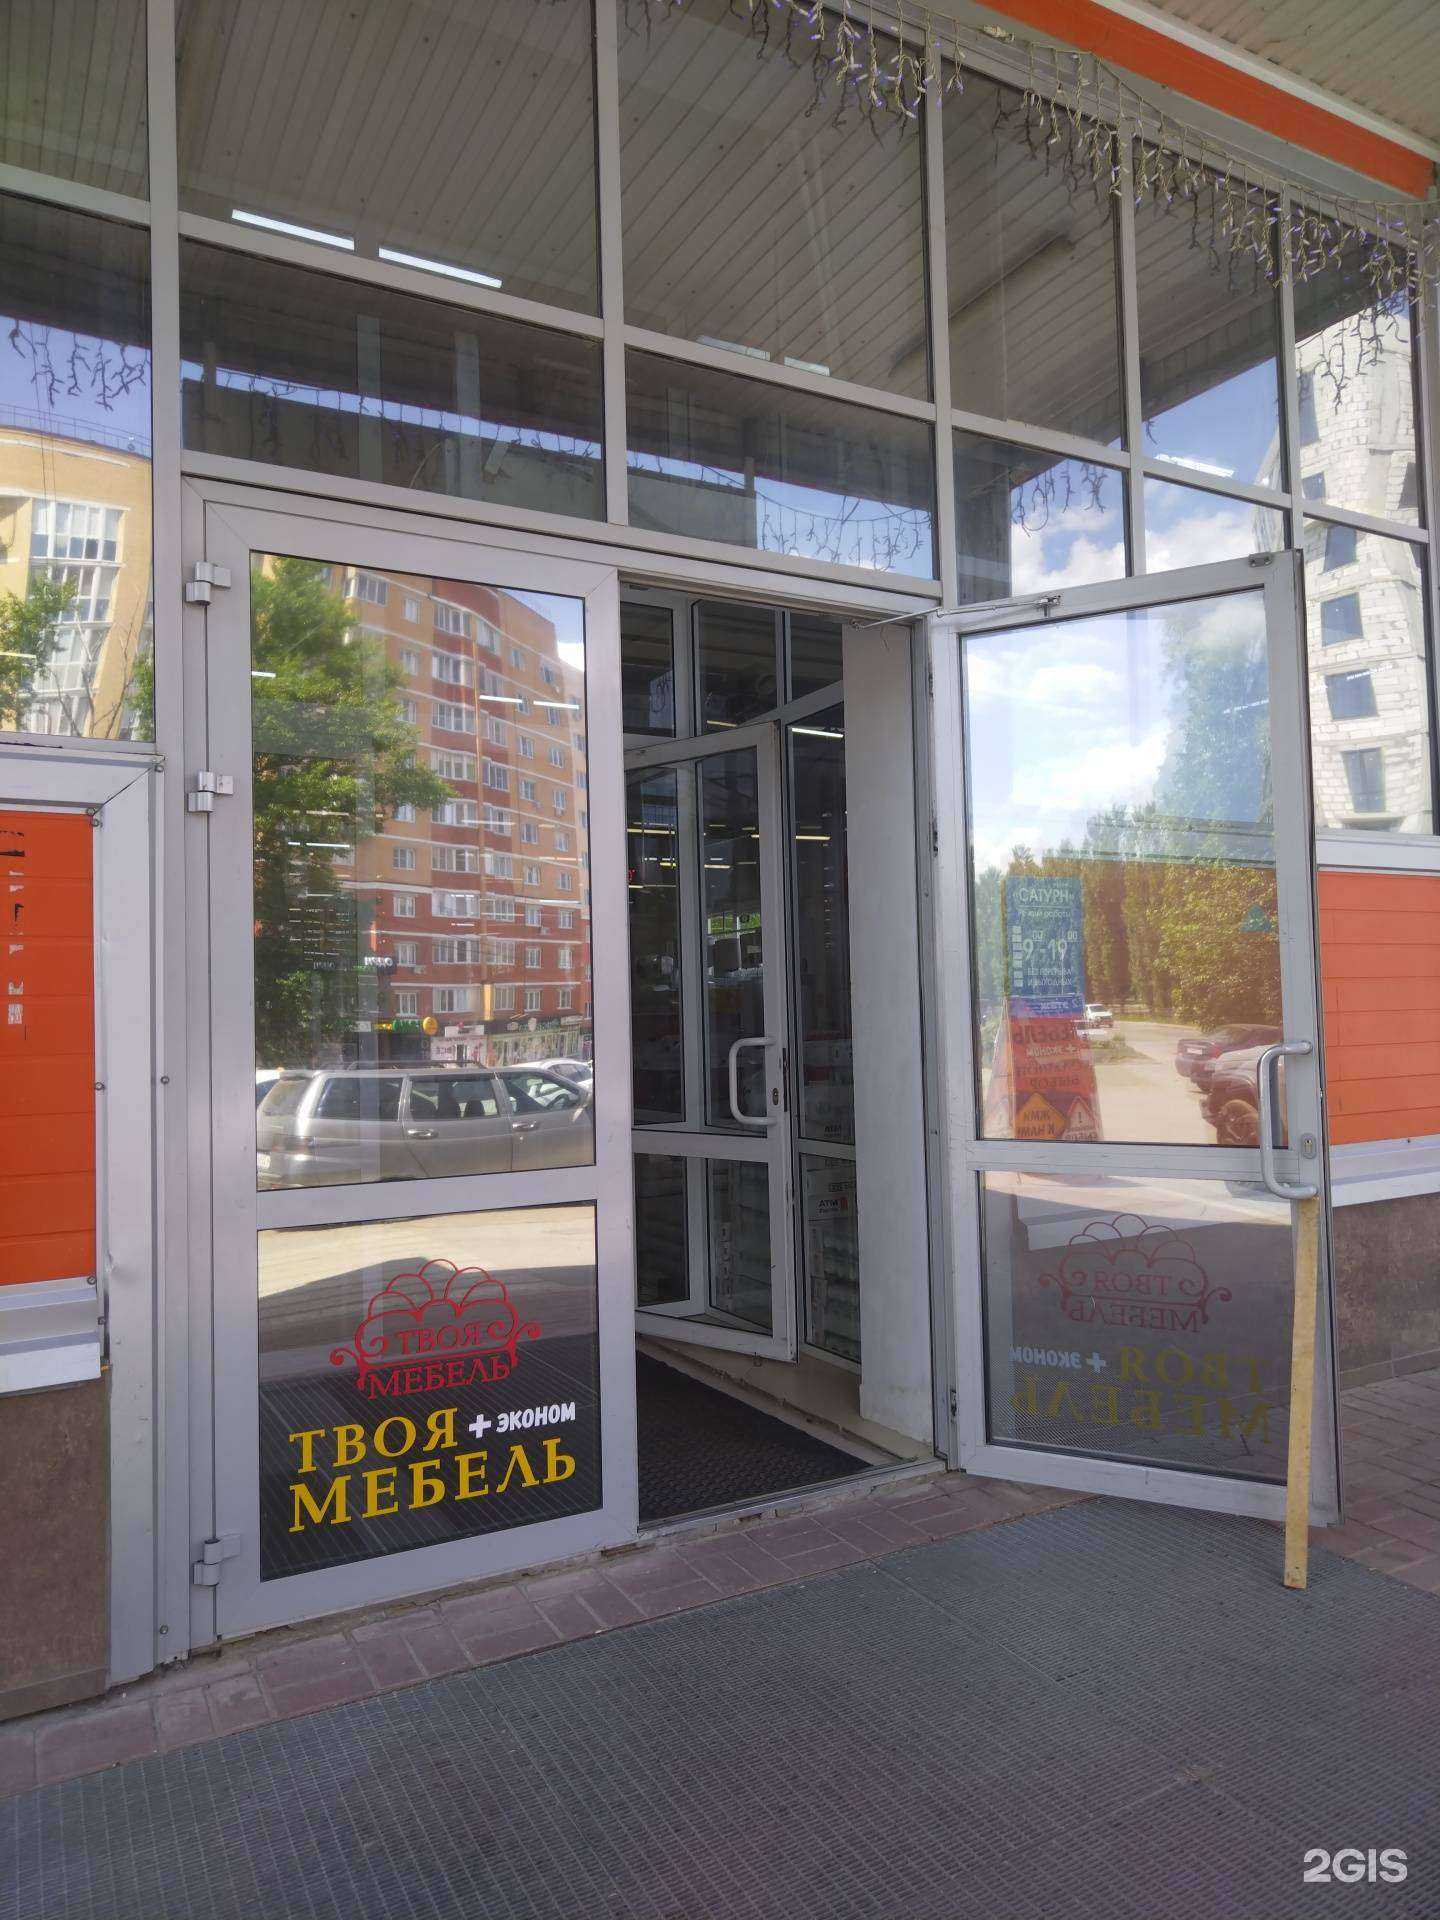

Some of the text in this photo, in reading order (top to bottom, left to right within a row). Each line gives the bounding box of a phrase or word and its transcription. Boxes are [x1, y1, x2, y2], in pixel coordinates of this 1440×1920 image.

[397, 1322, 482, 1356] ТВОЯ
[367, 1355, 511, 1400] МЕБЕЛЬ
[288, 1407, 458, 1474] ТВОЯ
[495, 1401, 576, 1433] ЭКОНОМ
[288, 1437, 577, 1533] МЕБЕЛЬ
